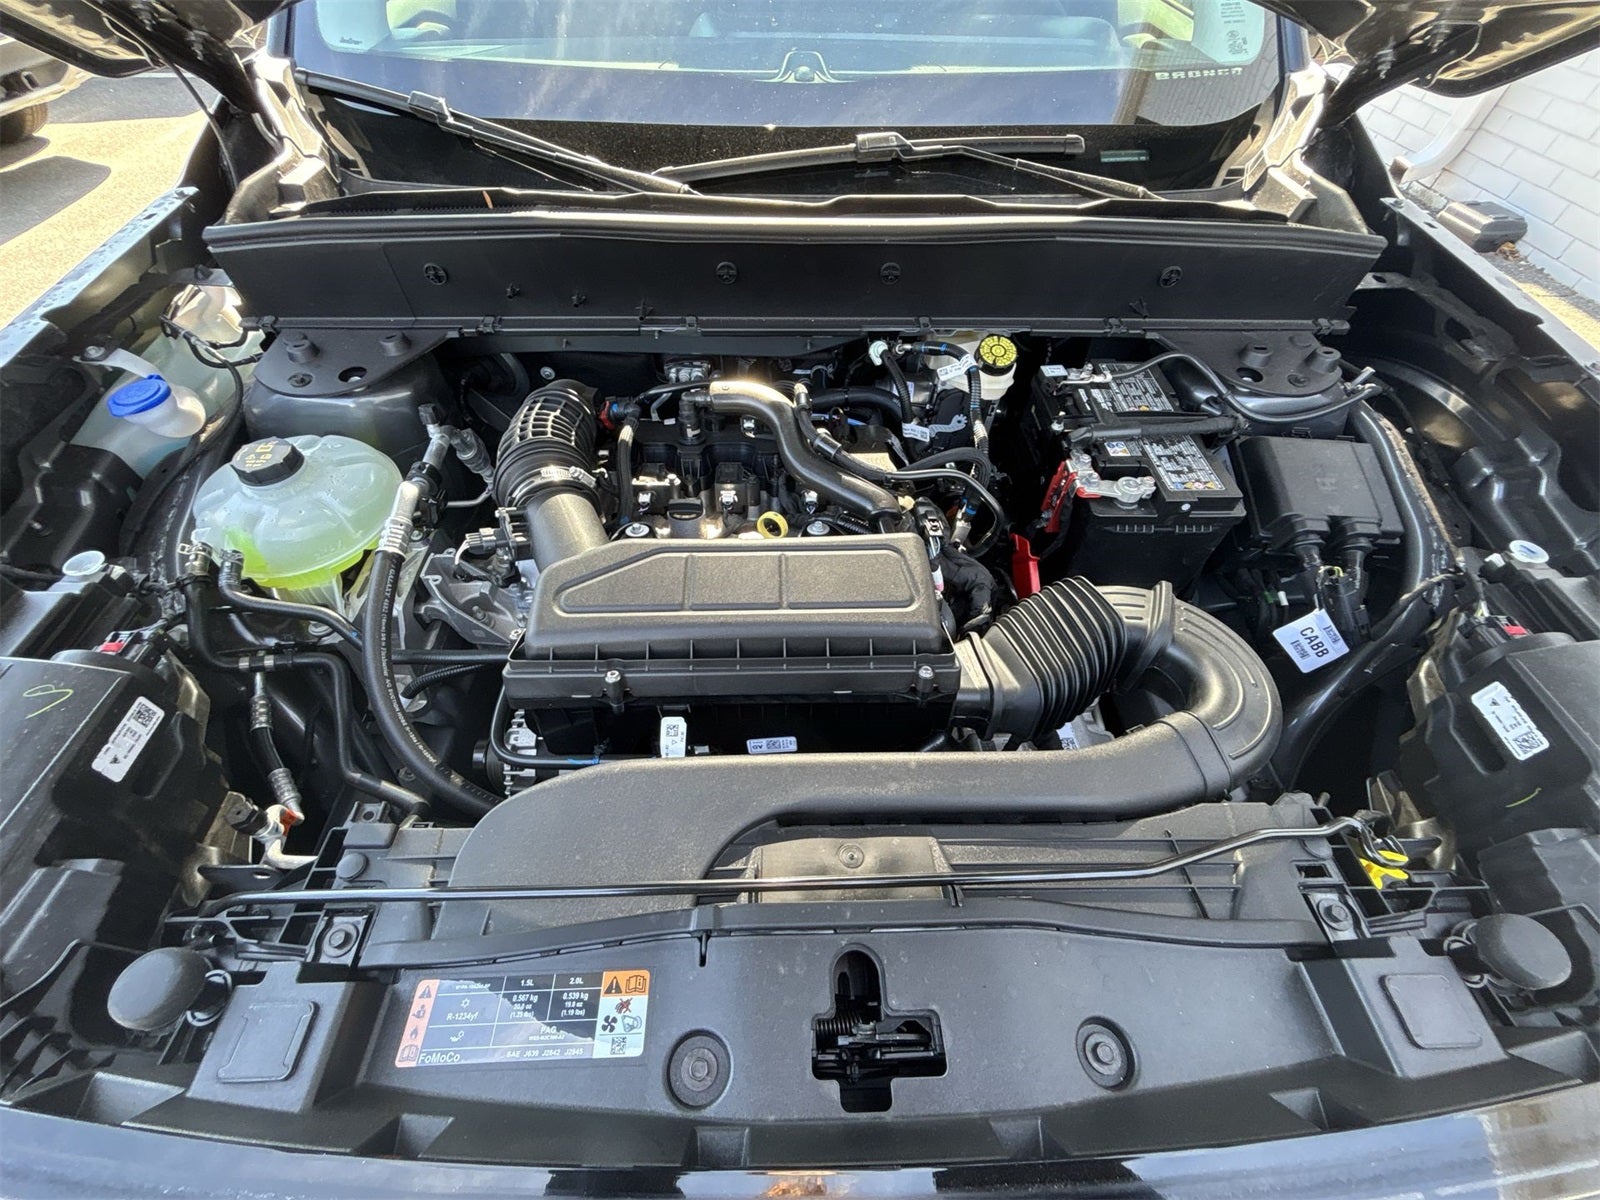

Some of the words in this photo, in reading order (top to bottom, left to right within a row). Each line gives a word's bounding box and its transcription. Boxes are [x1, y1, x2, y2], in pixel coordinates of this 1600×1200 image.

[1300, 626, 1330, 658] CABB
[520, 978, 534, 987] 1.5L
[569, 977, 584, 985] 2.0L
[512, 994, 529, 1002] 0.567
[529, 994, 539, 1003] kg
[562, 992, 579, 1001] 0.539
[579, 992, 589, 1001] kg
[446, 1011, 479, 1022] R-1234yf
[540, 1025, 557, 1034] PAG
[418, 1051, 461, 1064] FoMoCo
[506, 1050, 521, 1058] SAE
